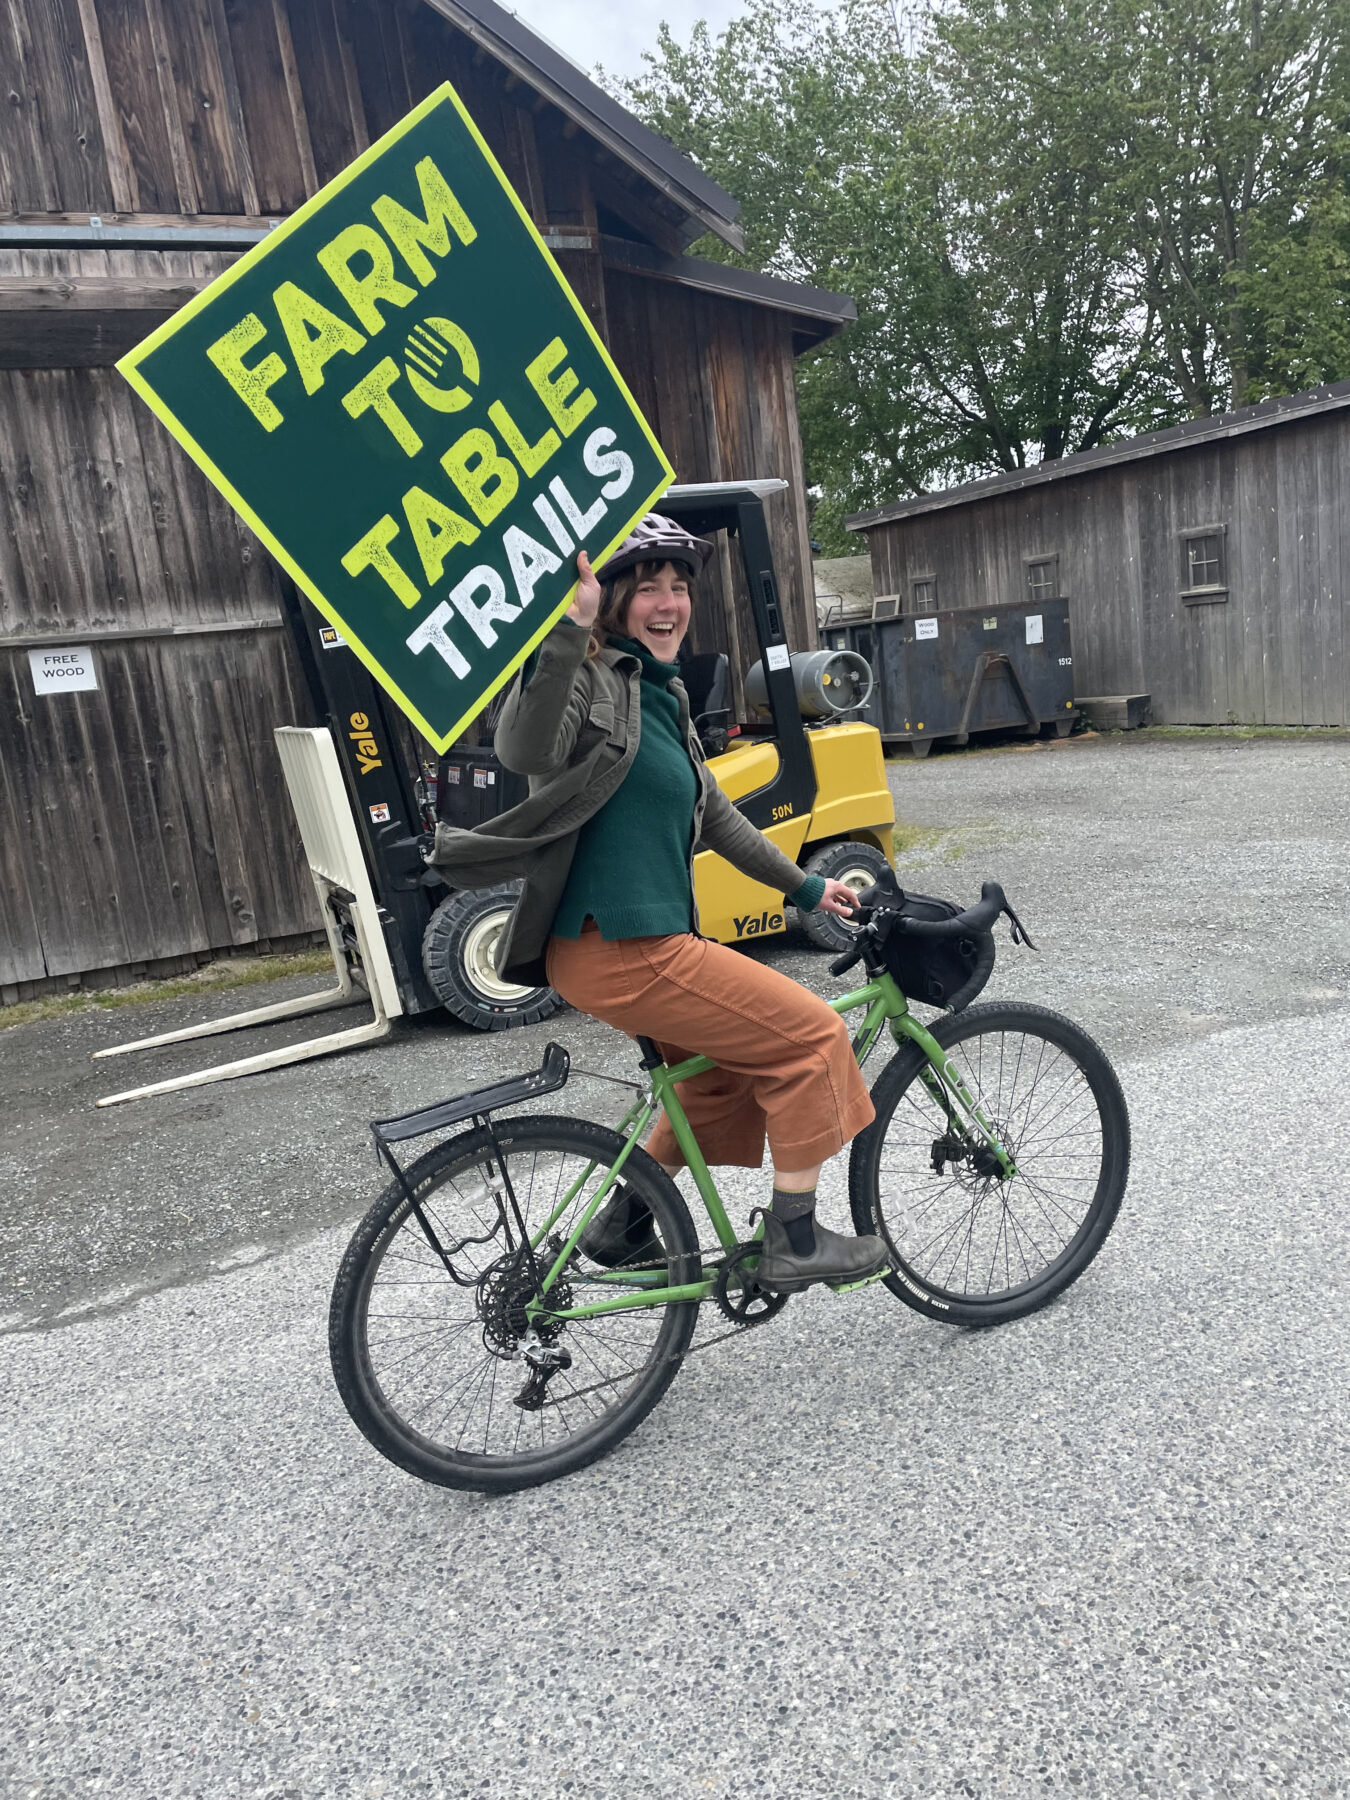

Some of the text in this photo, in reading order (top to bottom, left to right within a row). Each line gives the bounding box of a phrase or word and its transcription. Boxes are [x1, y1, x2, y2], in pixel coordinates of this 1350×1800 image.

[206, 155, 478, 433] FARM
[341, 316, 480, 458] TO
[341, 336, 598, 609] TABLE
[406, 426, 634, 680] TRAILS
[42, 667, 85, 678] WOOD
[43, 654, 79, 665] FREE
[1058, 657, 1072, 666] 1512
[349, 711, 383, 775] Yale
[772, 802, 793, 821] 50N
[733, 911, 783, 937] Yale
